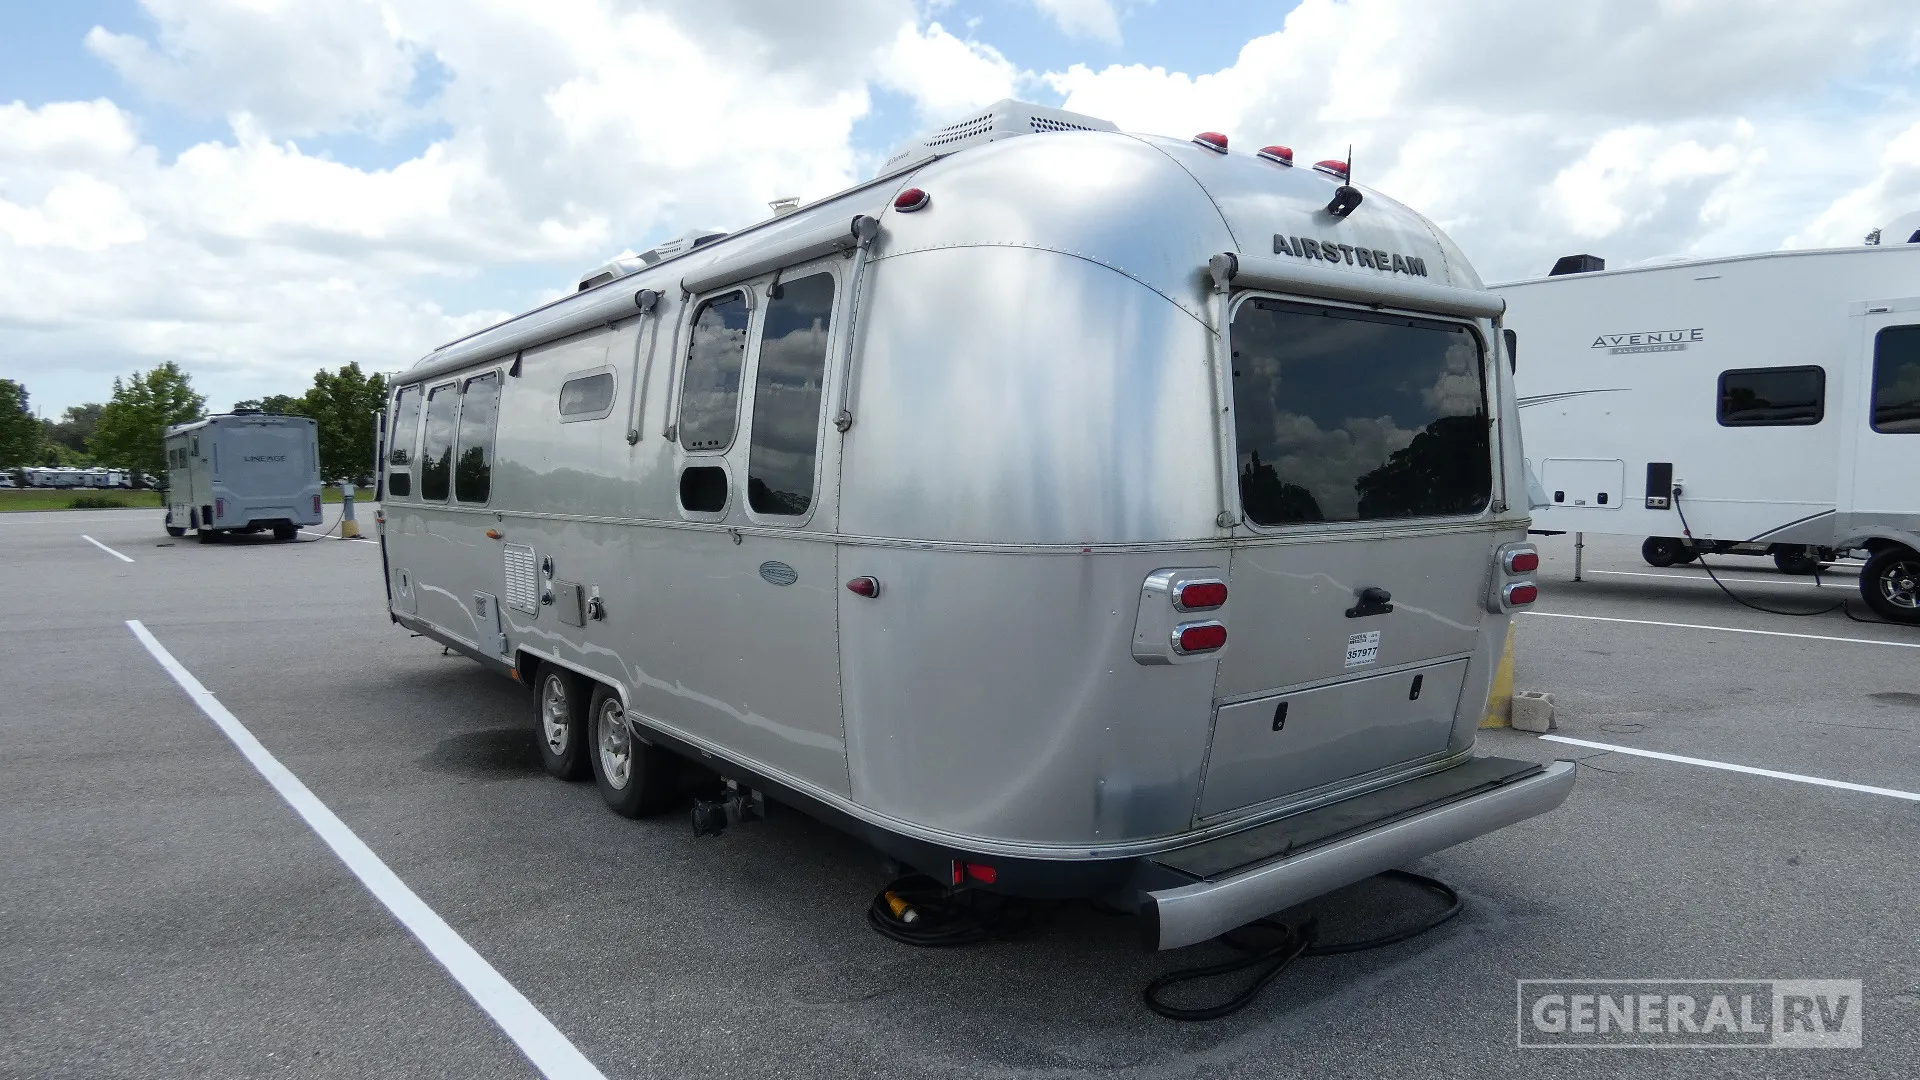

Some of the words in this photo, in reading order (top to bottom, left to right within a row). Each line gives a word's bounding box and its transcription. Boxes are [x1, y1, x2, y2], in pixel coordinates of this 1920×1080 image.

[1273, 233, 1428, 277] AIRSTREAM
[1592, 328, 1704, 347] AVENUE
[1346, 646, 1378, 660] 357977
